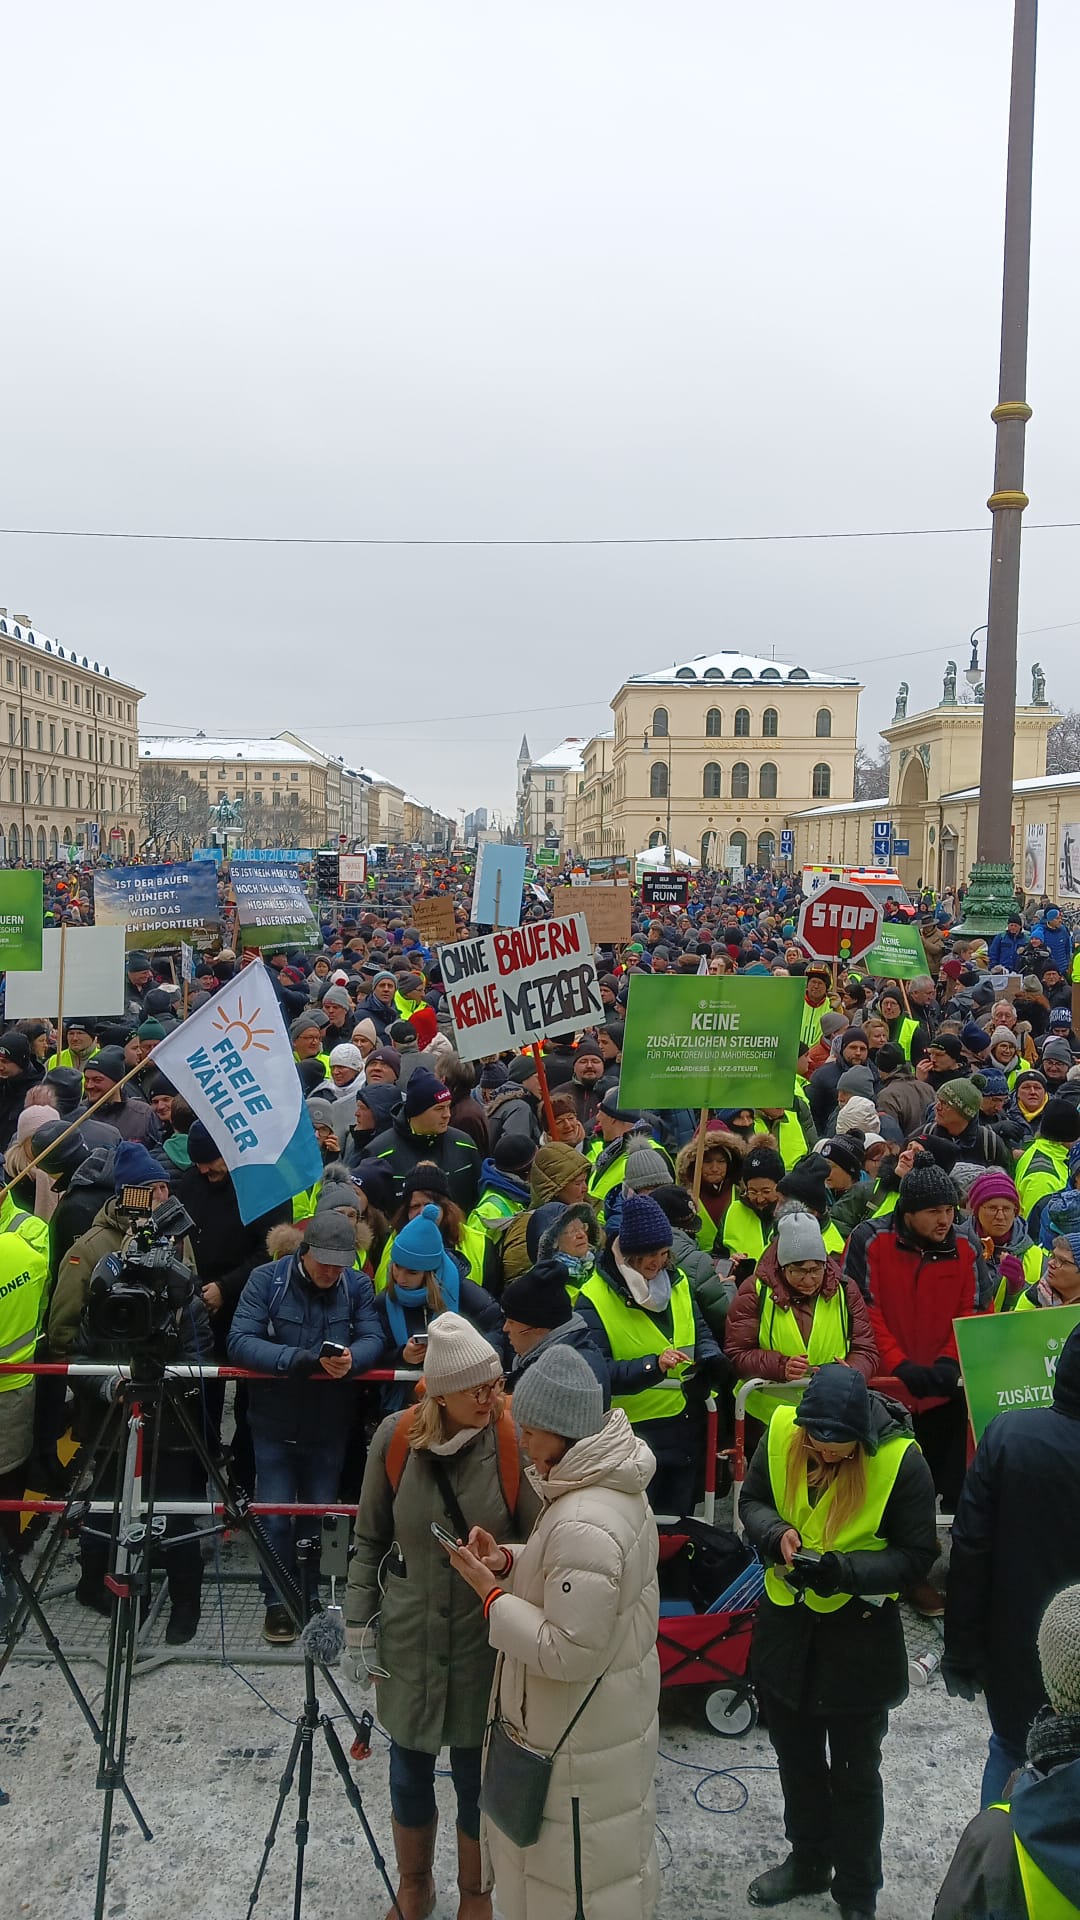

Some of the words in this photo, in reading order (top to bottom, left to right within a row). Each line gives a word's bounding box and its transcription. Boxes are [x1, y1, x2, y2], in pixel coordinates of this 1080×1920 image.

[783, 832, 789, 840] U
[878, 824, 886, 836] U
[231, 868, 239, 876] ES
[241, 868, 252, 877] IST
[289, 870, 298, 879] SO
[116, 879, 131, 889] IST
[134, 878, 154, 888] DER
[156, 875, 189, 886] BAUER
[236, 884, 258, 893] HOCH
[653, 892, 676, 901] RUIN
[130, 908, 157, 917] WIRD
[160, 905, 181, 914] DAS
[812, 903, 875, 930] STOP
[142, 918, 205, 931] IMPORTIERT
[256, 916, 307, 926] BAUERNSTAND
[441, 940, 489, 983] OHNE
[493, 918, 579, 976] BAUERN
[451, 983, 502, 1030] KEINE
[502, 964, 601, 1035] METZGER
[691, 1013, 740, 1030] KEINE
[647, 1034, 727, 1048] ZUSÄTZLICHEN
[729, 1036, 779, 1048] STEUERN
[647, 1049, 661, 1059] FÜR
[662, 1050, 704, 1059] TRAKTOREN
[704, 1050, 720, 1059] UND
[212, 1037, 272, 1115] FREIE
[186, 1046, 258, 1153] WÄHLER
